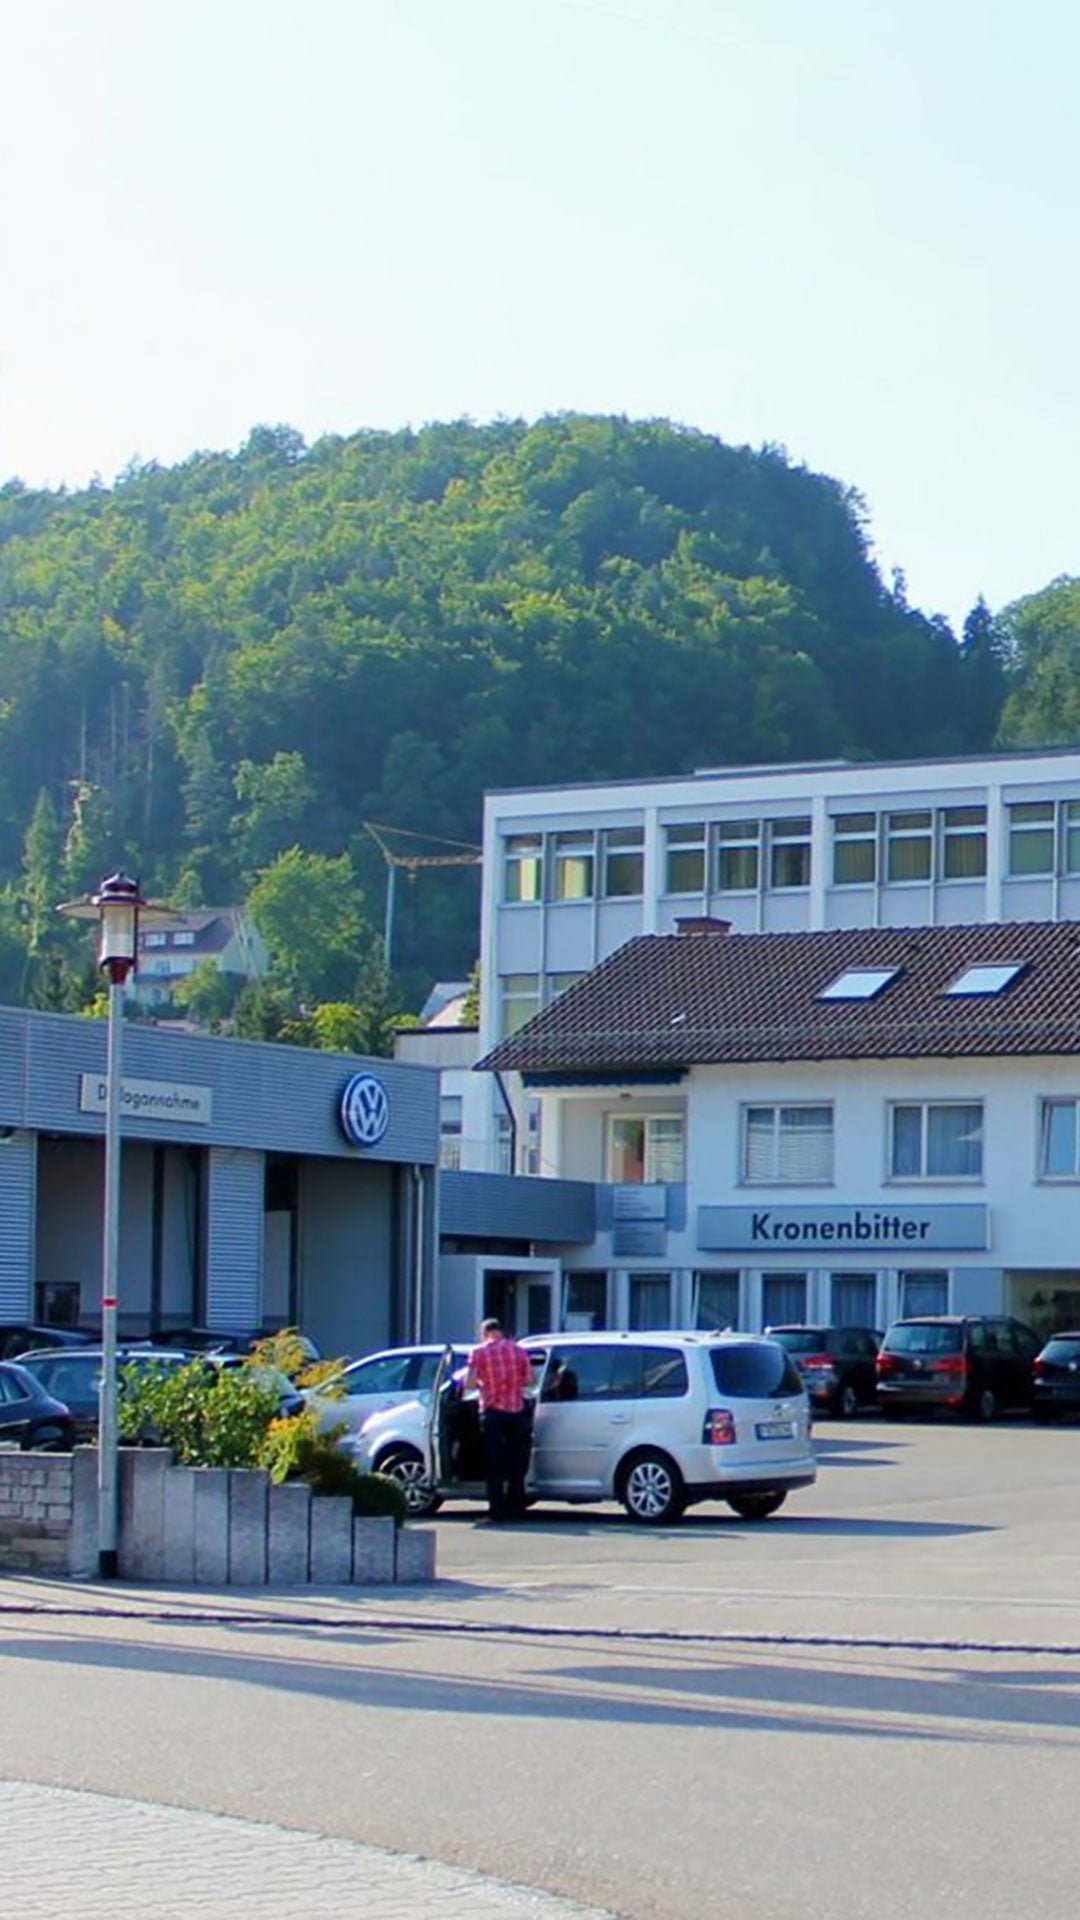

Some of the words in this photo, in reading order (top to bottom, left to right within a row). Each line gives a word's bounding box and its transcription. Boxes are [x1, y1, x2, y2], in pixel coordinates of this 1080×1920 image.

[98, 1084, 199, 1110] Dlogannahme
[350, 1079, 388, 1141] VW
[752, 1212, 931, 1240] Kronenbitter
